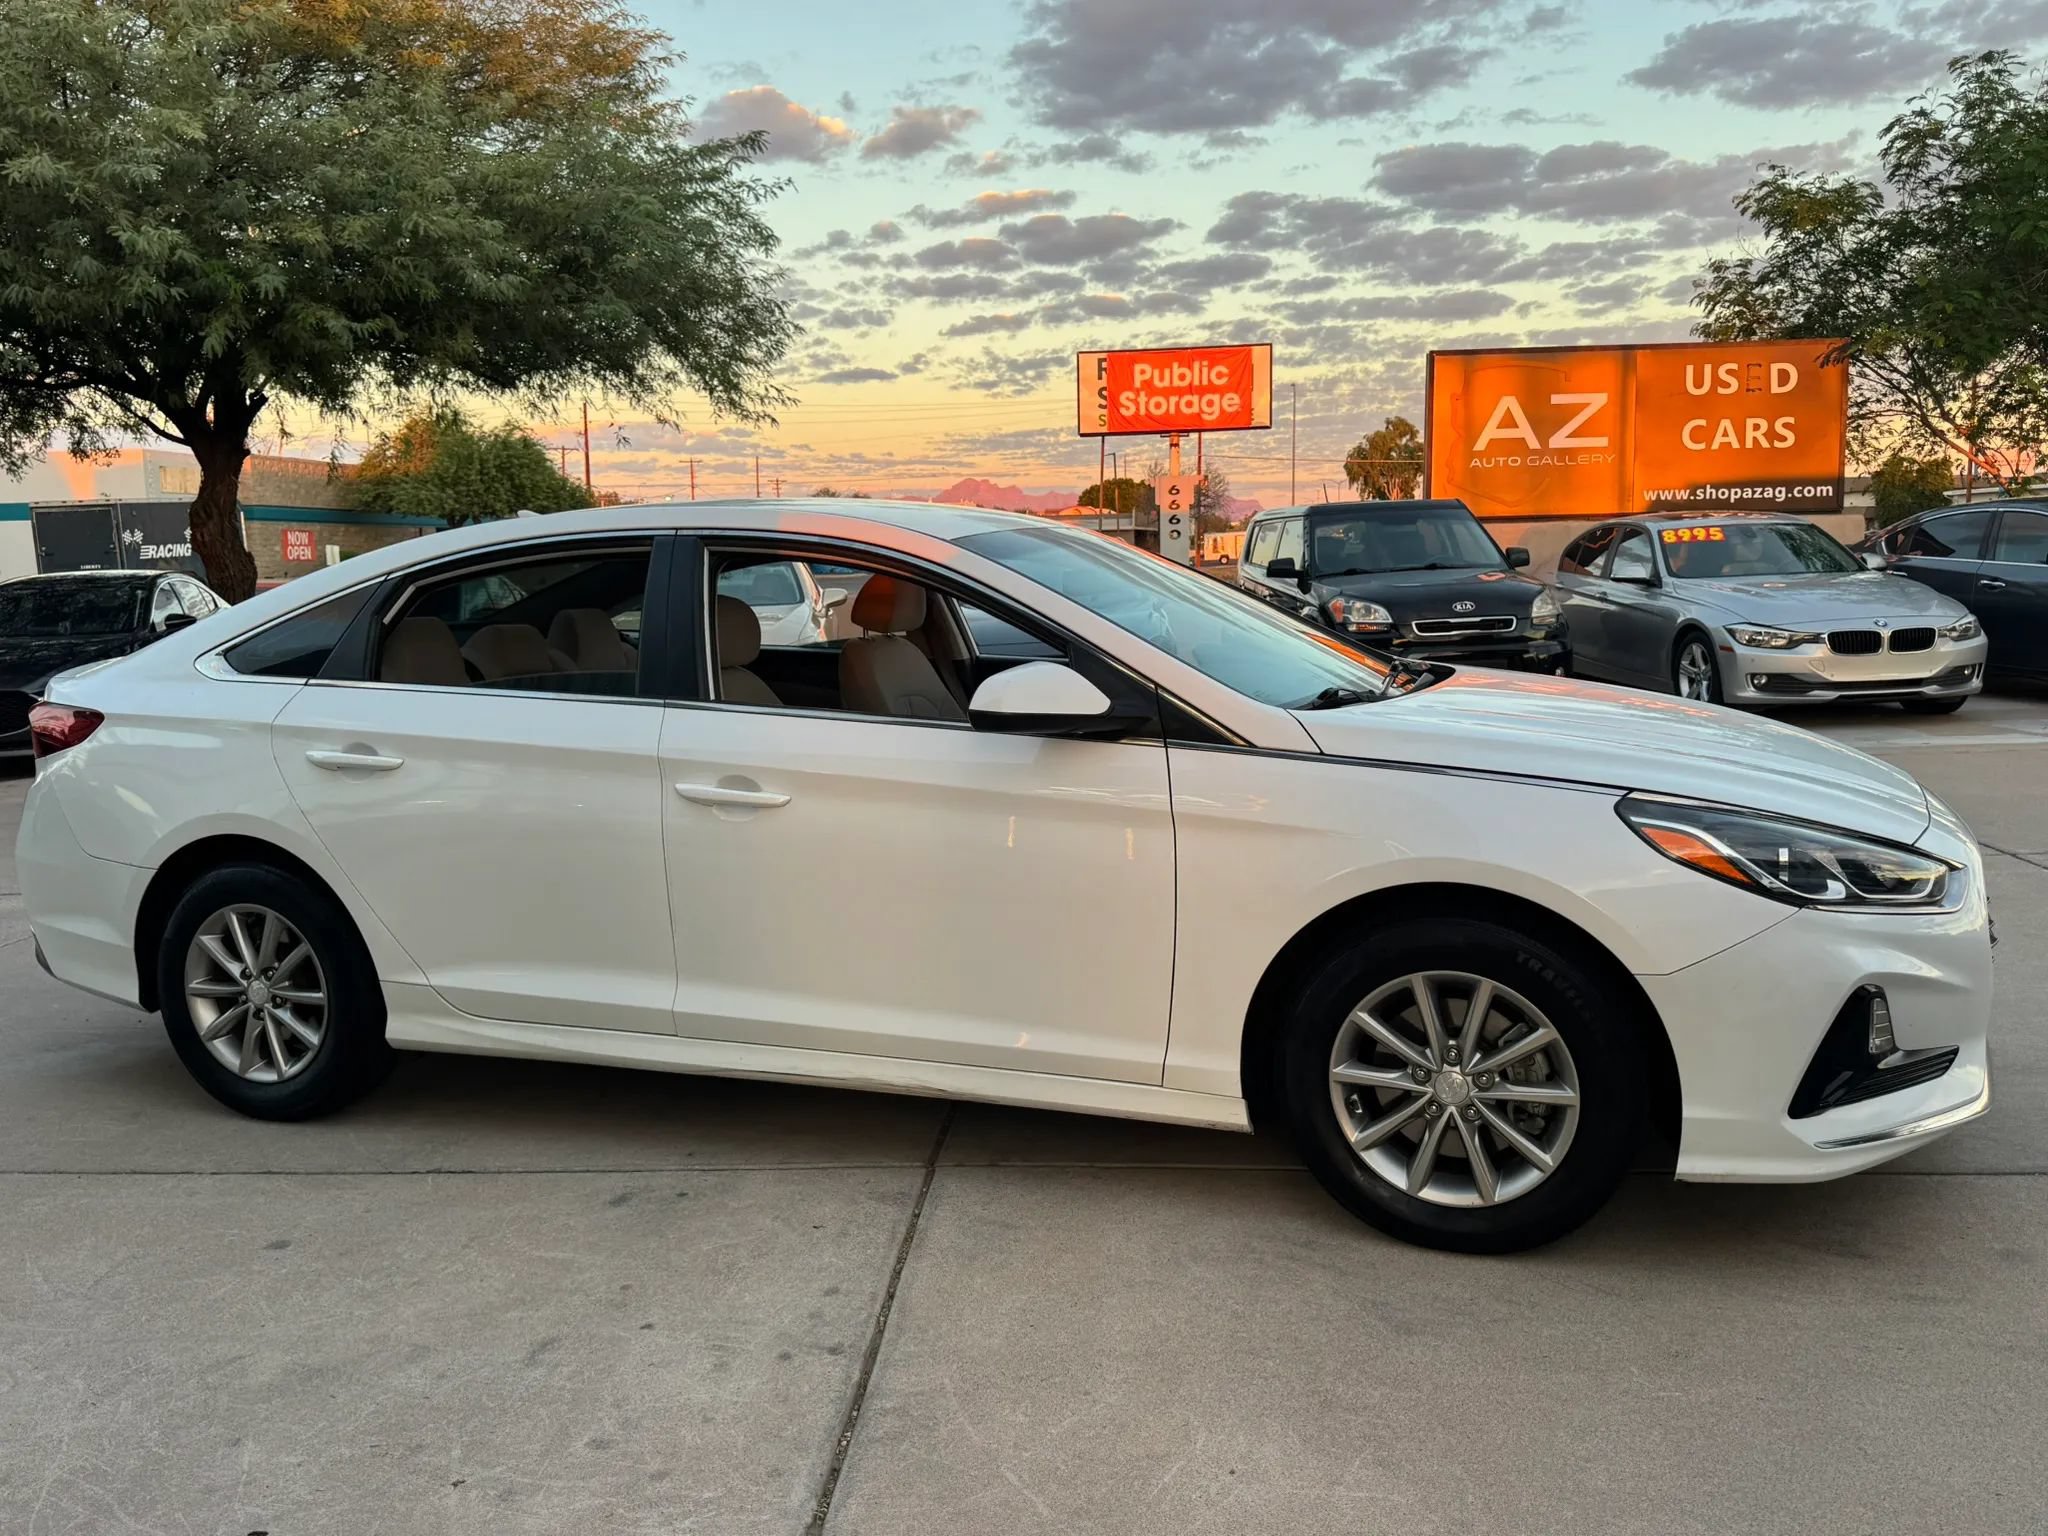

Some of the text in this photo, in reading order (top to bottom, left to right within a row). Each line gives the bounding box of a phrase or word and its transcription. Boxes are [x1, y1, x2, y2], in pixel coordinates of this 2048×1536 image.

[1133, 360, 1230, 388] Public
[1685, 362, 1799, 395] USED
[1119, 391, 1242, 421] Storage
[1472, 392, 1610, 451] AZ
[1681, 416, 1797, 450] CARS
[1469, 453, 1616, 468] AUTO GALLERY
[1643, 483, 1834, 503] www.shopazag.com
[287, 531, 309, 545] NOW
[1661, 526, 1724, 544] 8995
[140, 543, 192, 559] RACING
[287, 546, 312, 560] OPEN
